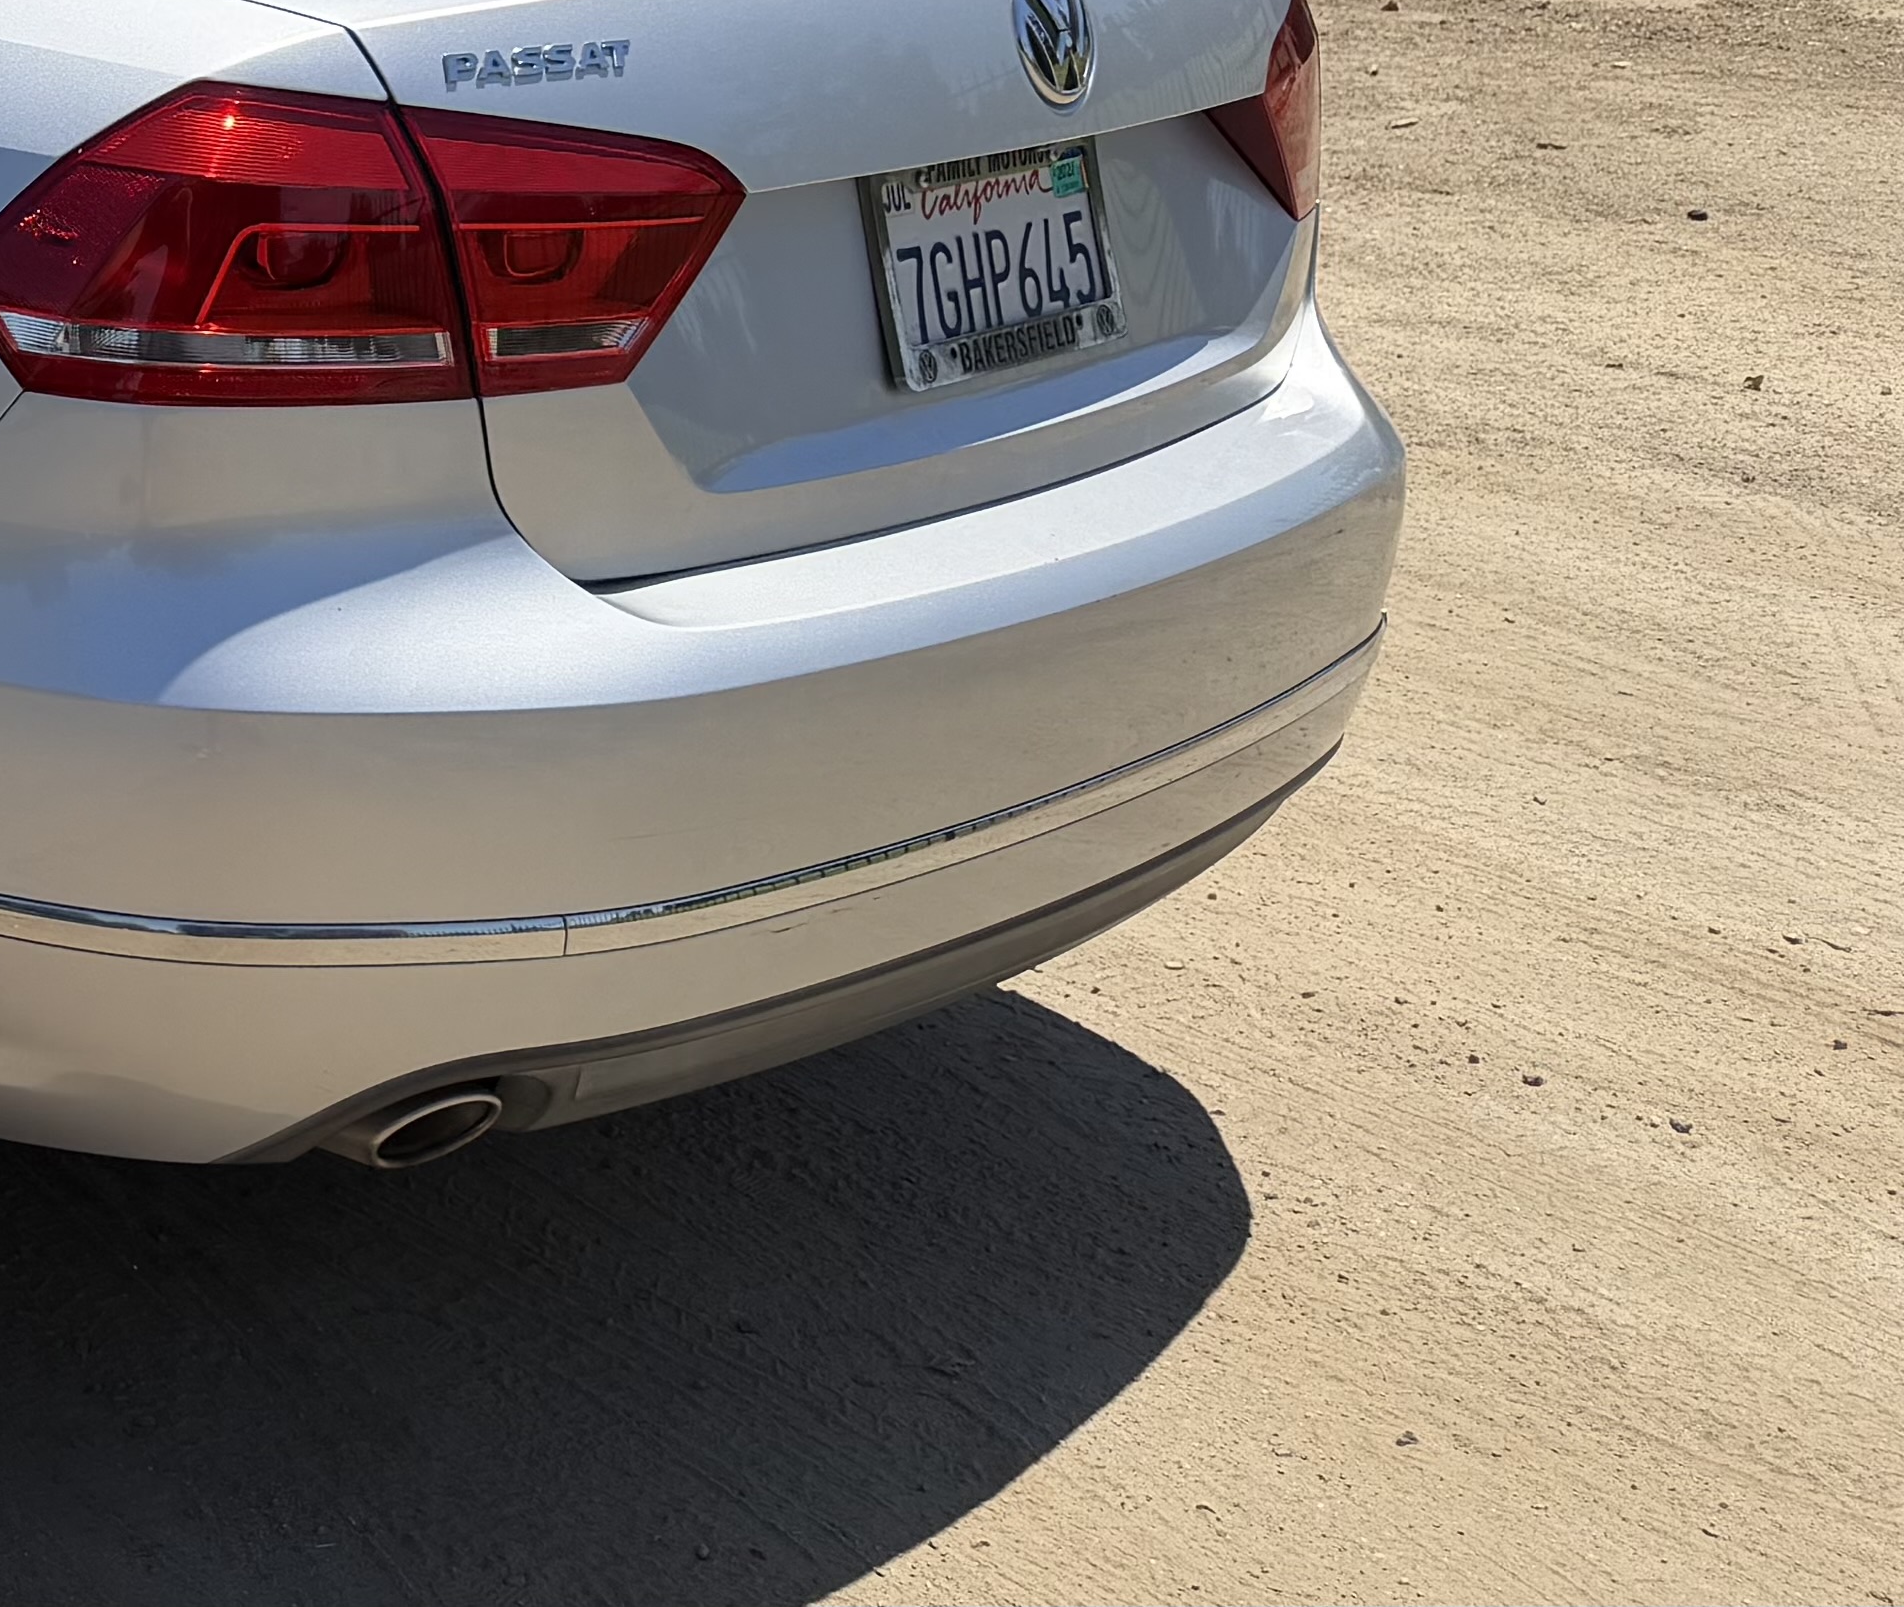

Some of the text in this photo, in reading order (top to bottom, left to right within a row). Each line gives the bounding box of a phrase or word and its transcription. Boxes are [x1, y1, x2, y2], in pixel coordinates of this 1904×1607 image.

[442, 39, 630, 89] PASSAT
[882, 182, 911, 214] JUL
[921, 169, 1053, 225] California
[896, 210, 1096, 345] 7GHP645
[960, 315, 1076, 374] BAKERSFIELD
